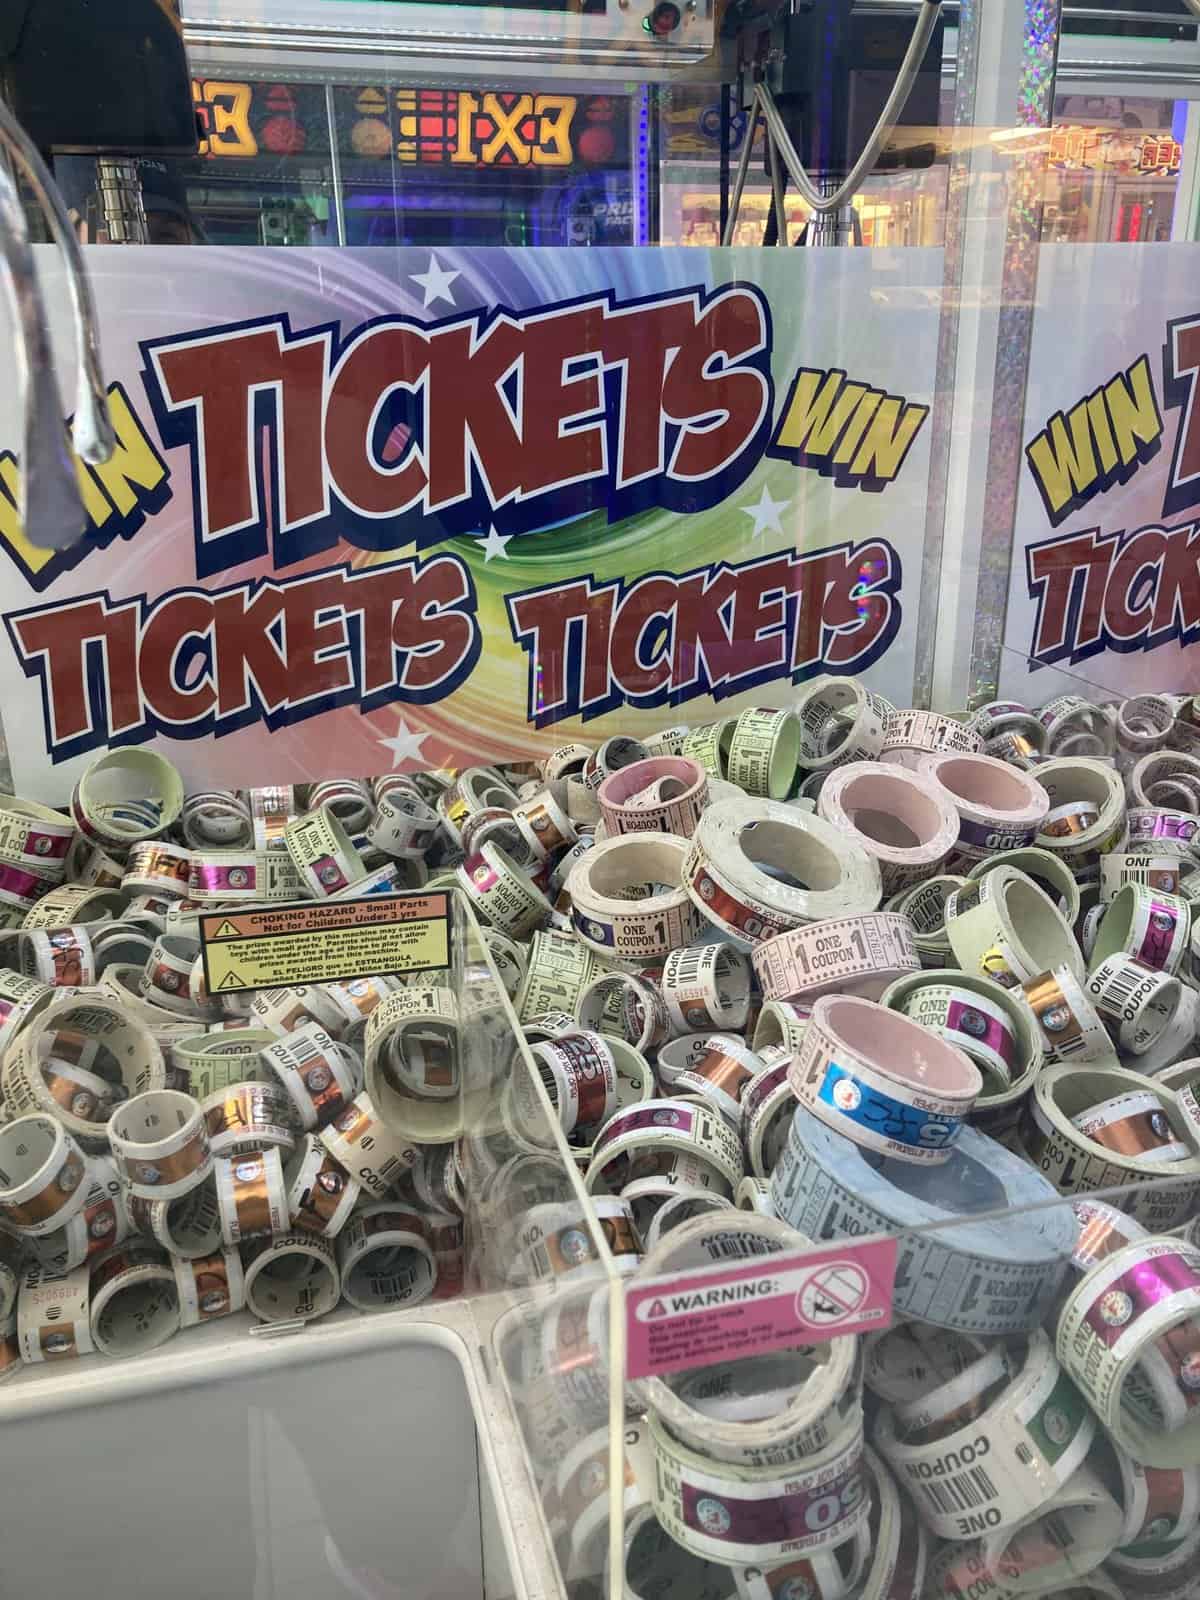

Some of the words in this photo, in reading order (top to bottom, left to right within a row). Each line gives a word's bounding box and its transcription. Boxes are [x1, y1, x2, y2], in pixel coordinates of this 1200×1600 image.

[145, 284, 770, 555] TICKETS
[774, 368, 928, 485] WIN
[1027, 356, 1162, 518] WIN
[508, 541, 895, 722] TICKETS
[7, 556, 477, 750] TICKETS
[250, 912, 305, 924] CHOKING
[309, 905, 356, 918] HAZARD
[366, 902, 397, 912] Small
[399, 900, 429, 909] Parts
[263, 923, 284, 932] Not
[287, 922, 304, 930] for
[305, 916, 352, 928] Children
[355, 912, 388, 922] Under
[391, 911, 397, 919] 3
[400, 910, 417, 920] yrs
[617, 934, 655, 948] COUPON
[623, 924, 647, 937] ONE
[654, 921, 667, 945] 1
[815, 934, 842, 951] ONE
[701, 945, 717, 970] ONE
[811, 947, 855, 970] COUPON
[1090, 966, 1114, 995] ONE
[381, 1001, 421, 1019] COUPON
[386, 994, 411, 1008] ONE
[422, 993, 434, 1008] 1
[919, 999, 947, 1013] ONE
[567, 1038, 604, 1081] 25
[671, 1280, 780, 1313] WARNING:
[905, 1434, 991, 1480] COUPON
[956, 1507, 1002, 1536] ONE
